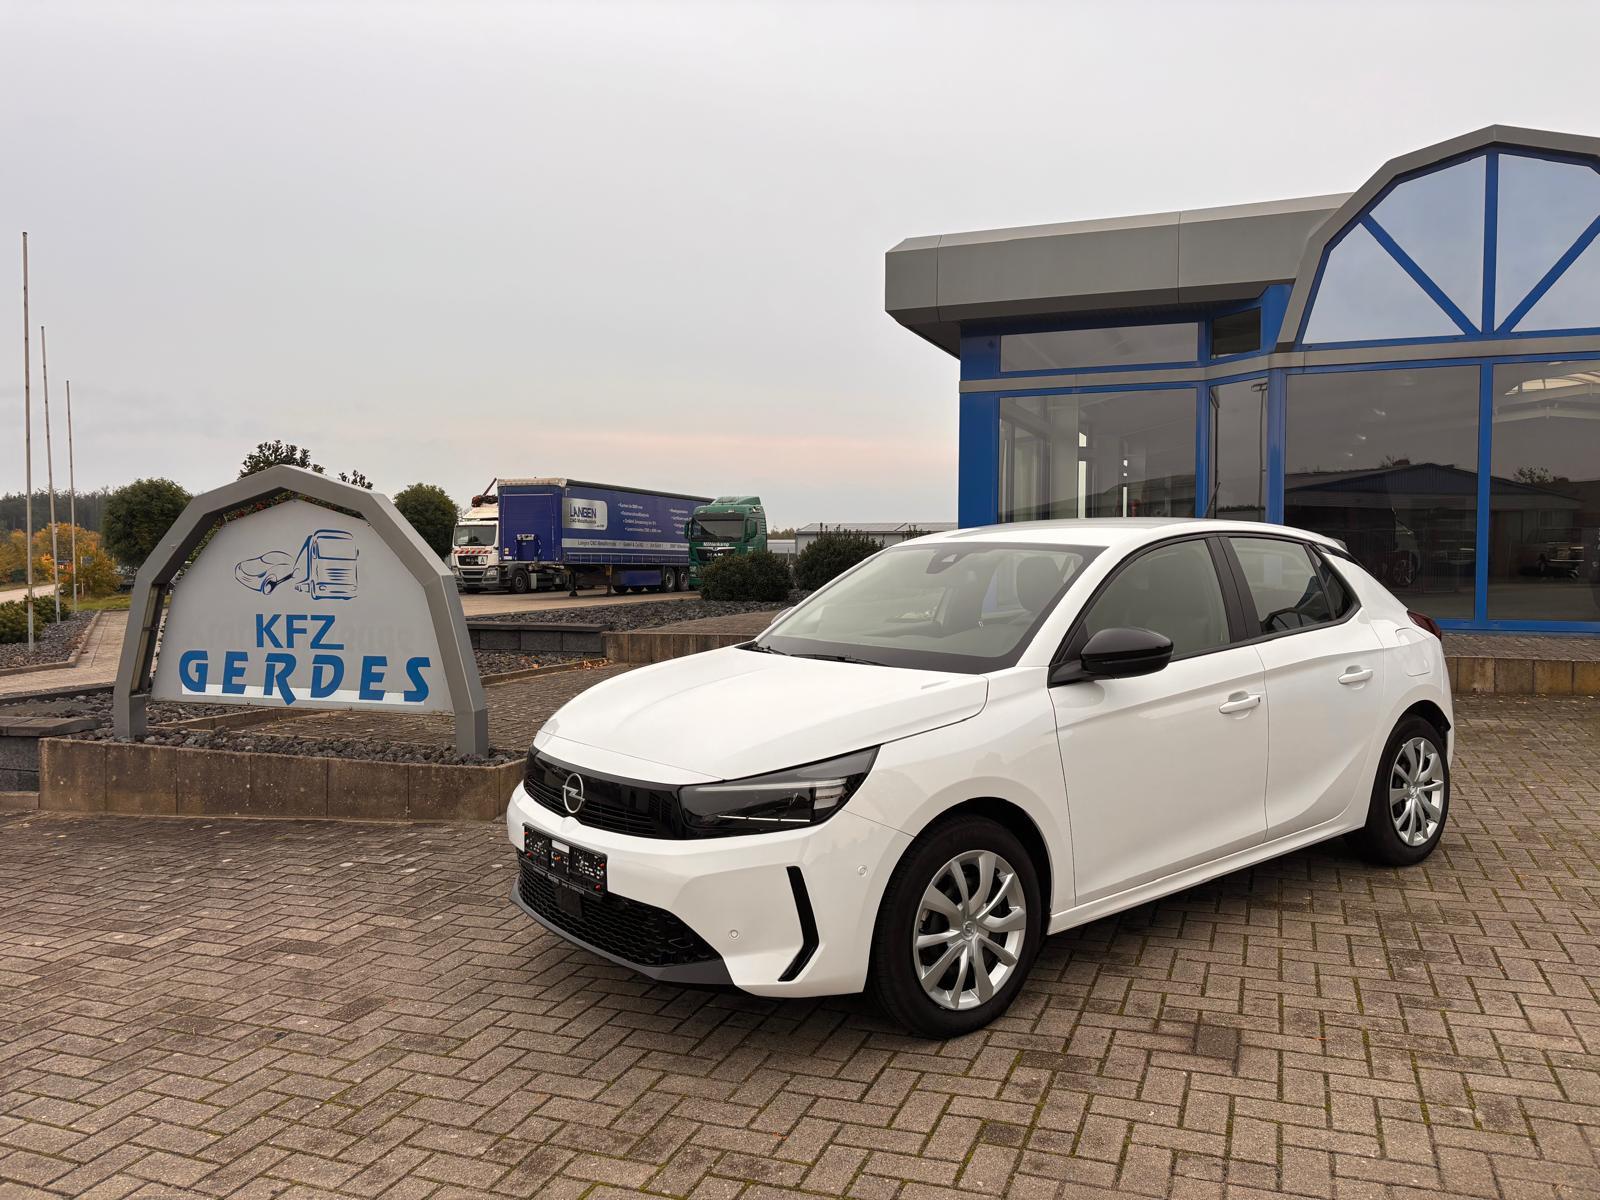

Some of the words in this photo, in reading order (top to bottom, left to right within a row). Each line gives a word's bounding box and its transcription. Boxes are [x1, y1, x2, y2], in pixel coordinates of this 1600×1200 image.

[570, 503, 597, 518] LANGEN
[256, 613, 344, 650] KFZ
[178, 649, 431, 705] GERDES
